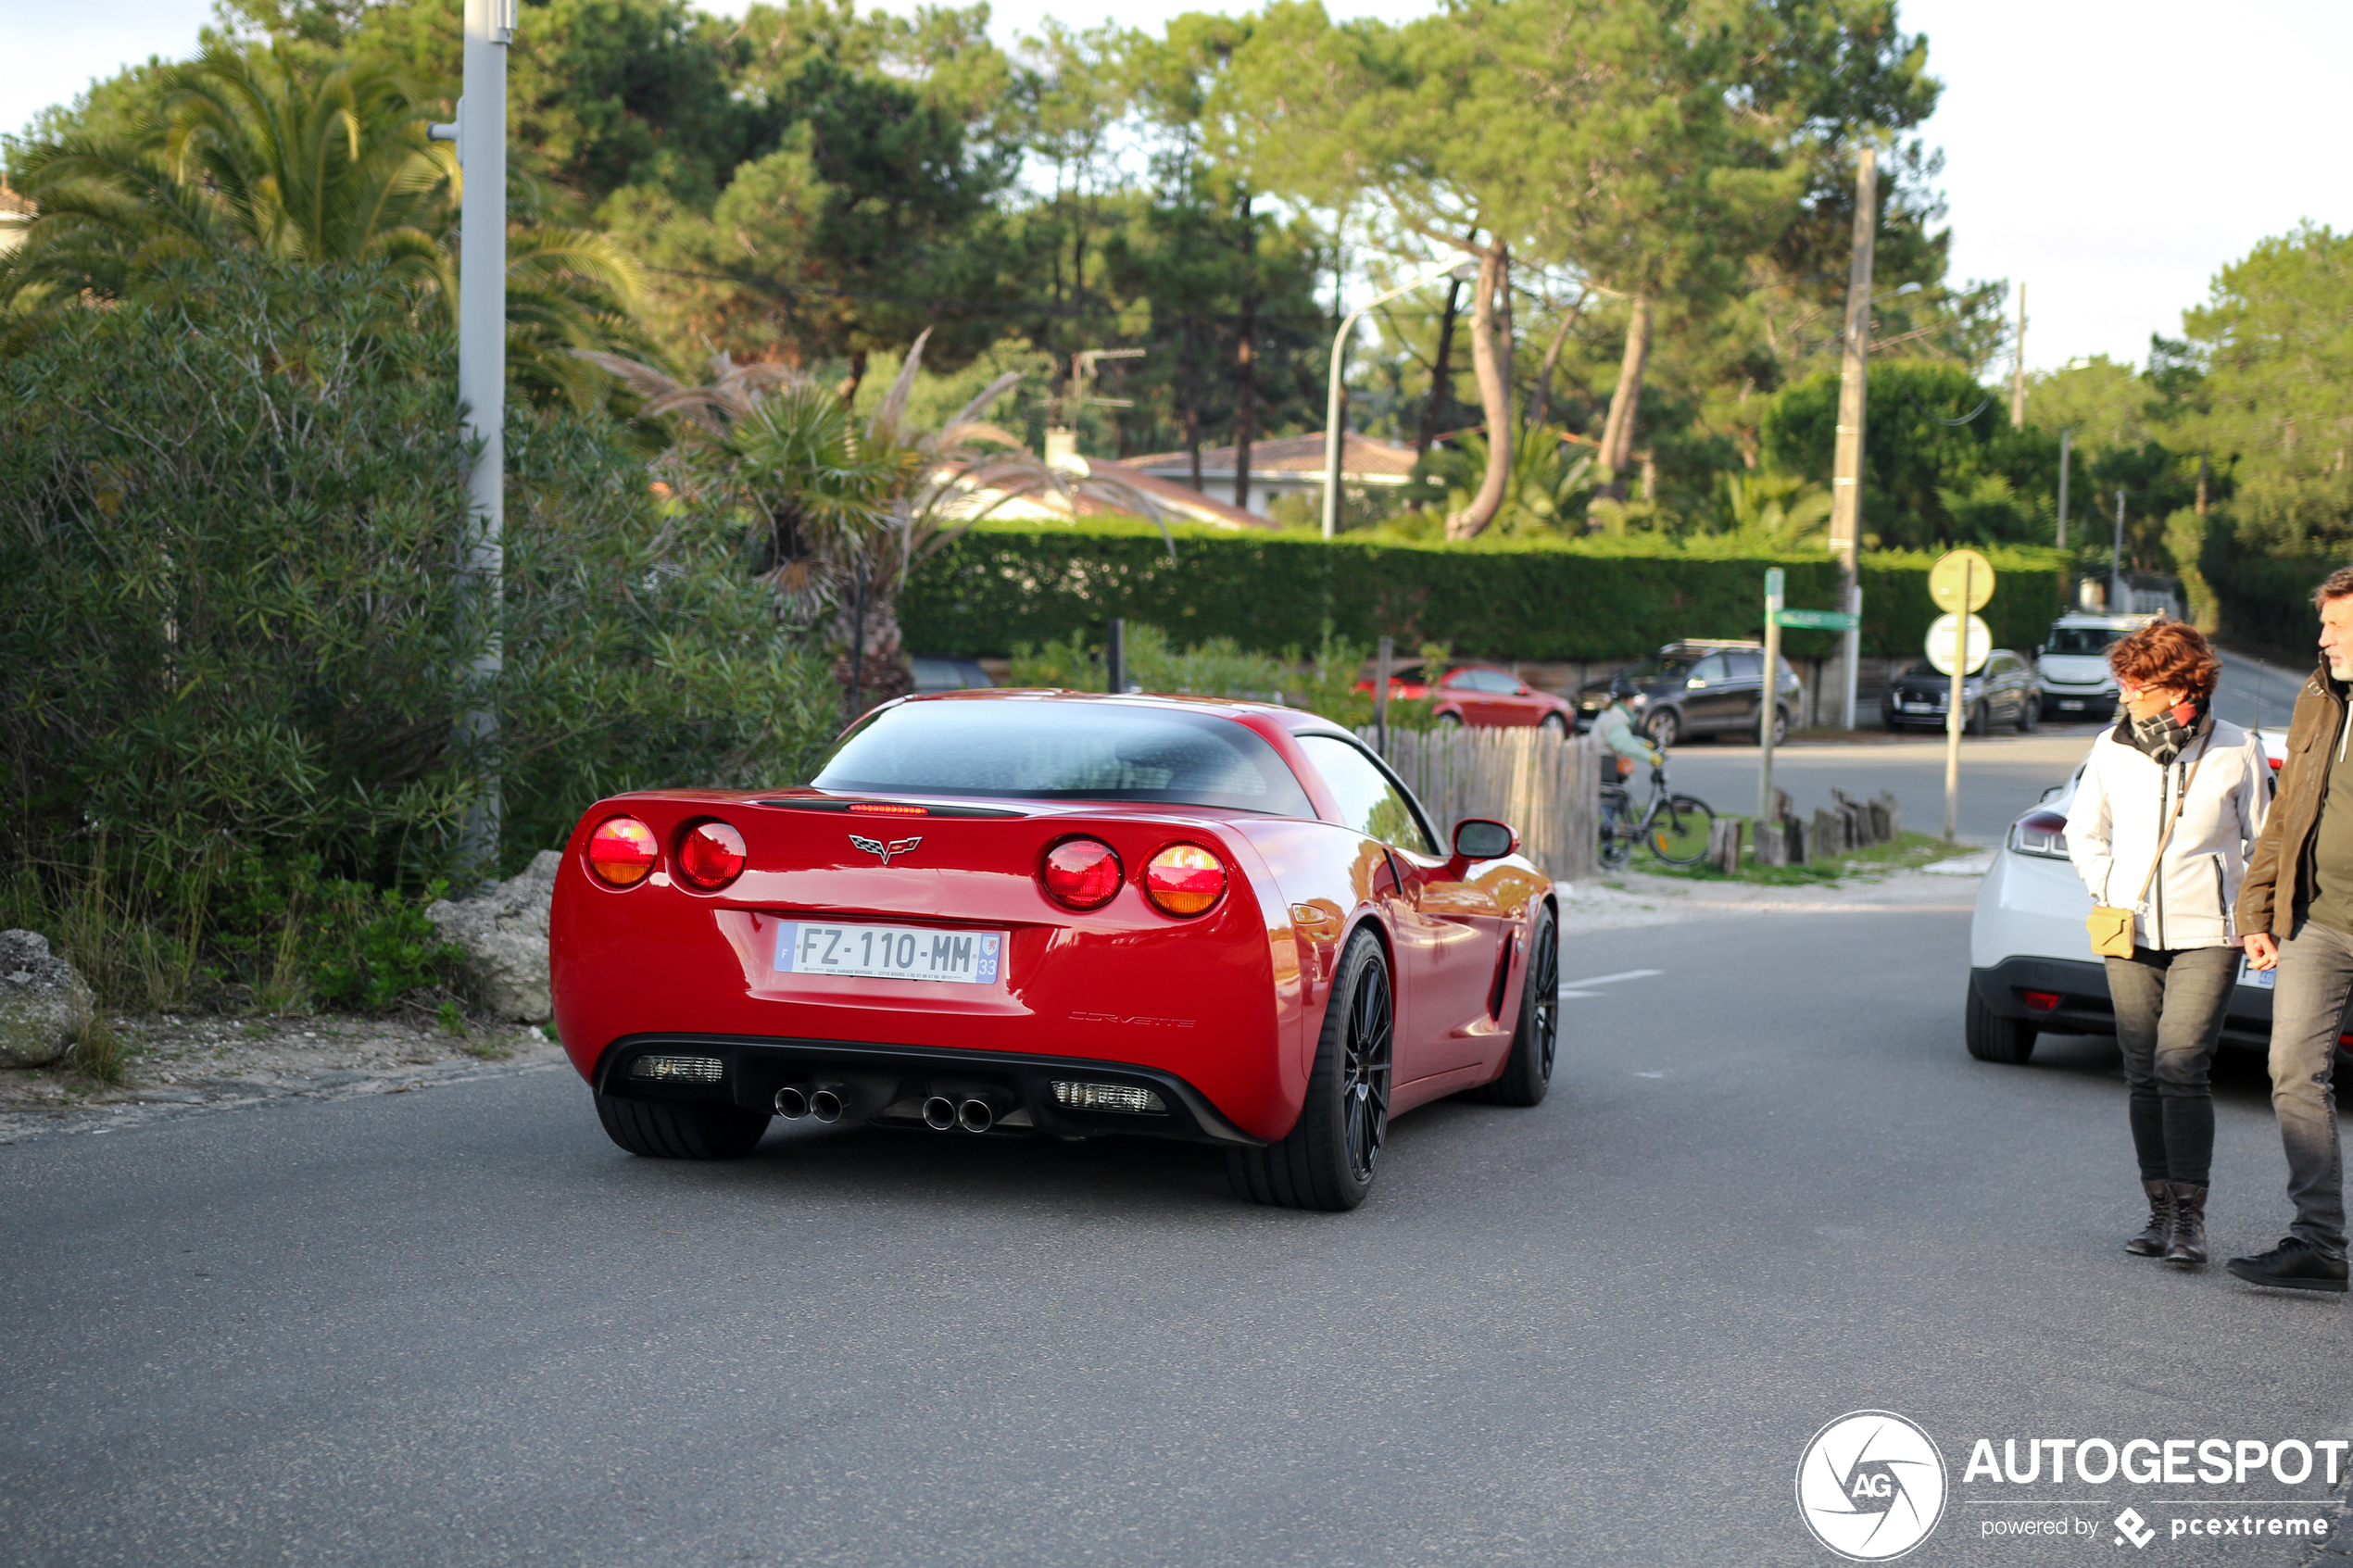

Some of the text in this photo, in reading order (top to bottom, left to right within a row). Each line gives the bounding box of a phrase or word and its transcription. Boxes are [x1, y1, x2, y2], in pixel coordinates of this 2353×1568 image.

[781, 948, 787, 959] F
[801, 928, 972, 972] FZ-110-MM
[979, 959, 997, 975] 33
[1069, 1011, 1196, 1028] CORVETTE
